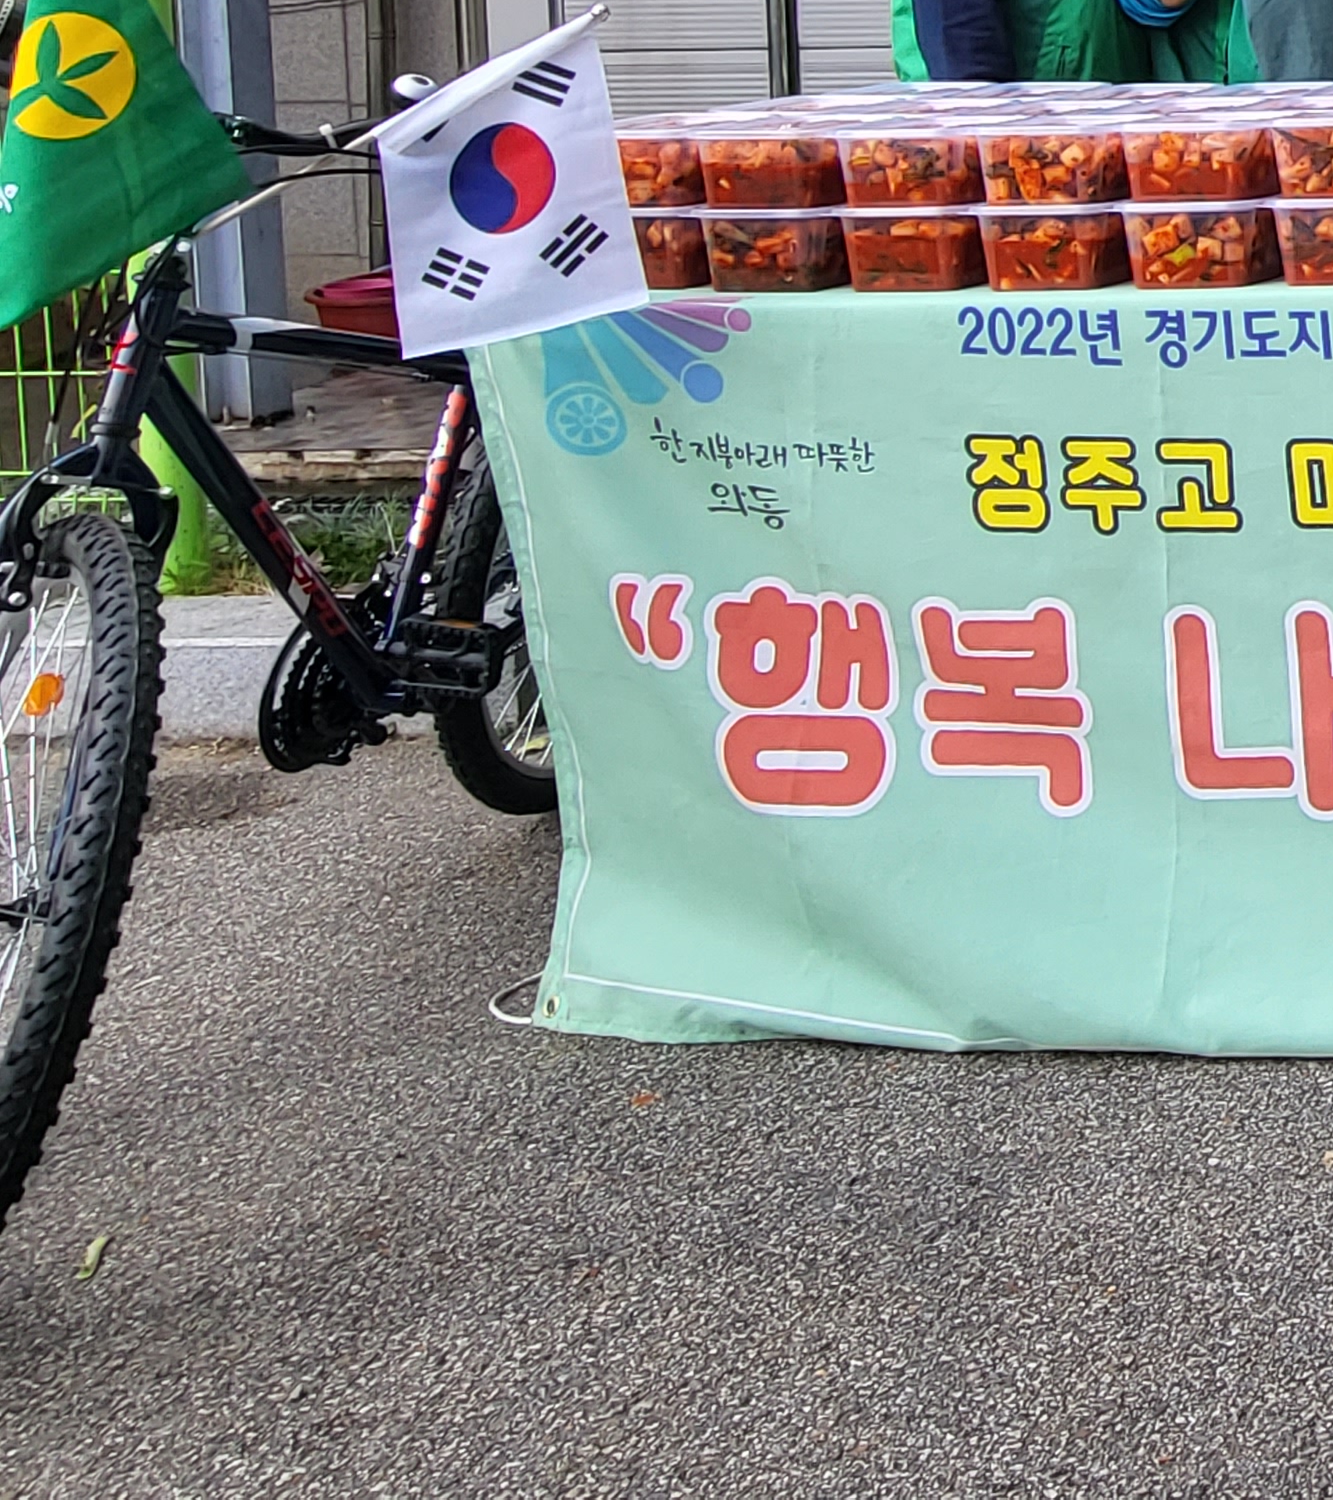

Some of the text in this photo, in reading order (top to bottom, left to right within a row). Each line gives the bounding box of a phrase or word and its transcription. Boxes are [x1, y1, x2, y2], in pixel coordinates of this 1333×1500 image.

[958, 306, 1122, 367] 2022년
[650, 416, 687, 464] 한
[792, 436, 876, 473] 따뜻한
[707, 483, 791, 530] 와동
[613, 578, 1088, 811] “행복
